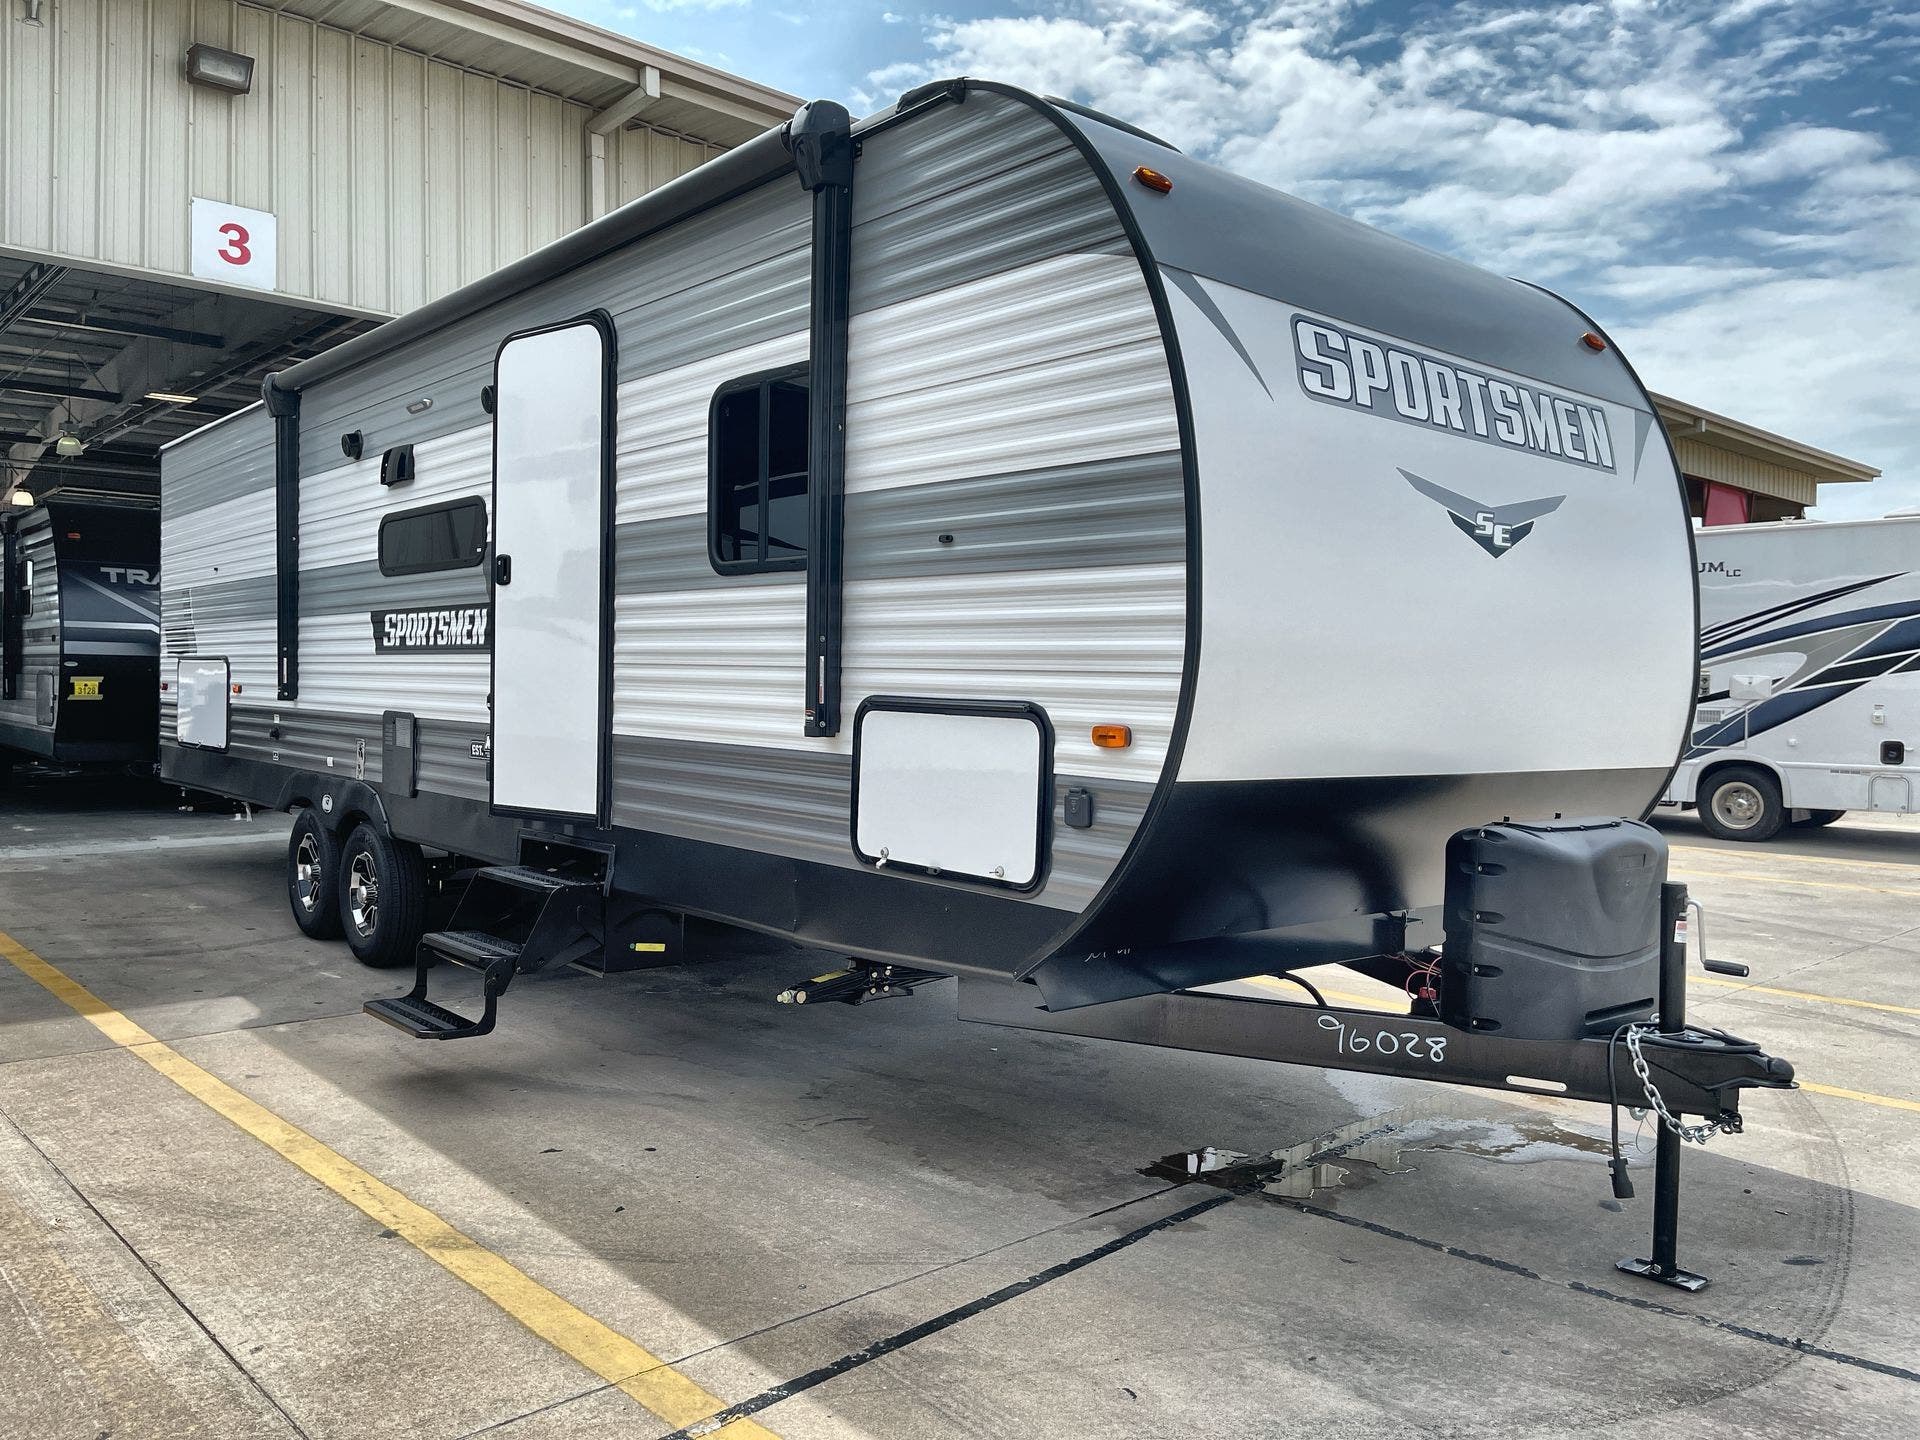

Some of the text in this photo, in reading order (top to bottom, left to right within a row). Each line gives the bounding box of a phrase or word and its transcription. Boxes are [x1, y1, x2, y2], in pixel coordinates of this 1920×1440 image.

[218, 223, 251, 265] 3
[1296, 321, 1614, 469] SPORTSMEN
[1475, 512, 1512, 547] SE
[1726, 569, 1741, 577] LC
[383, 608, 487, 646] SPORTSMEN
[471, 744, 483, 756] EST.
[1317, 1014, 1447, 1063] 96028
